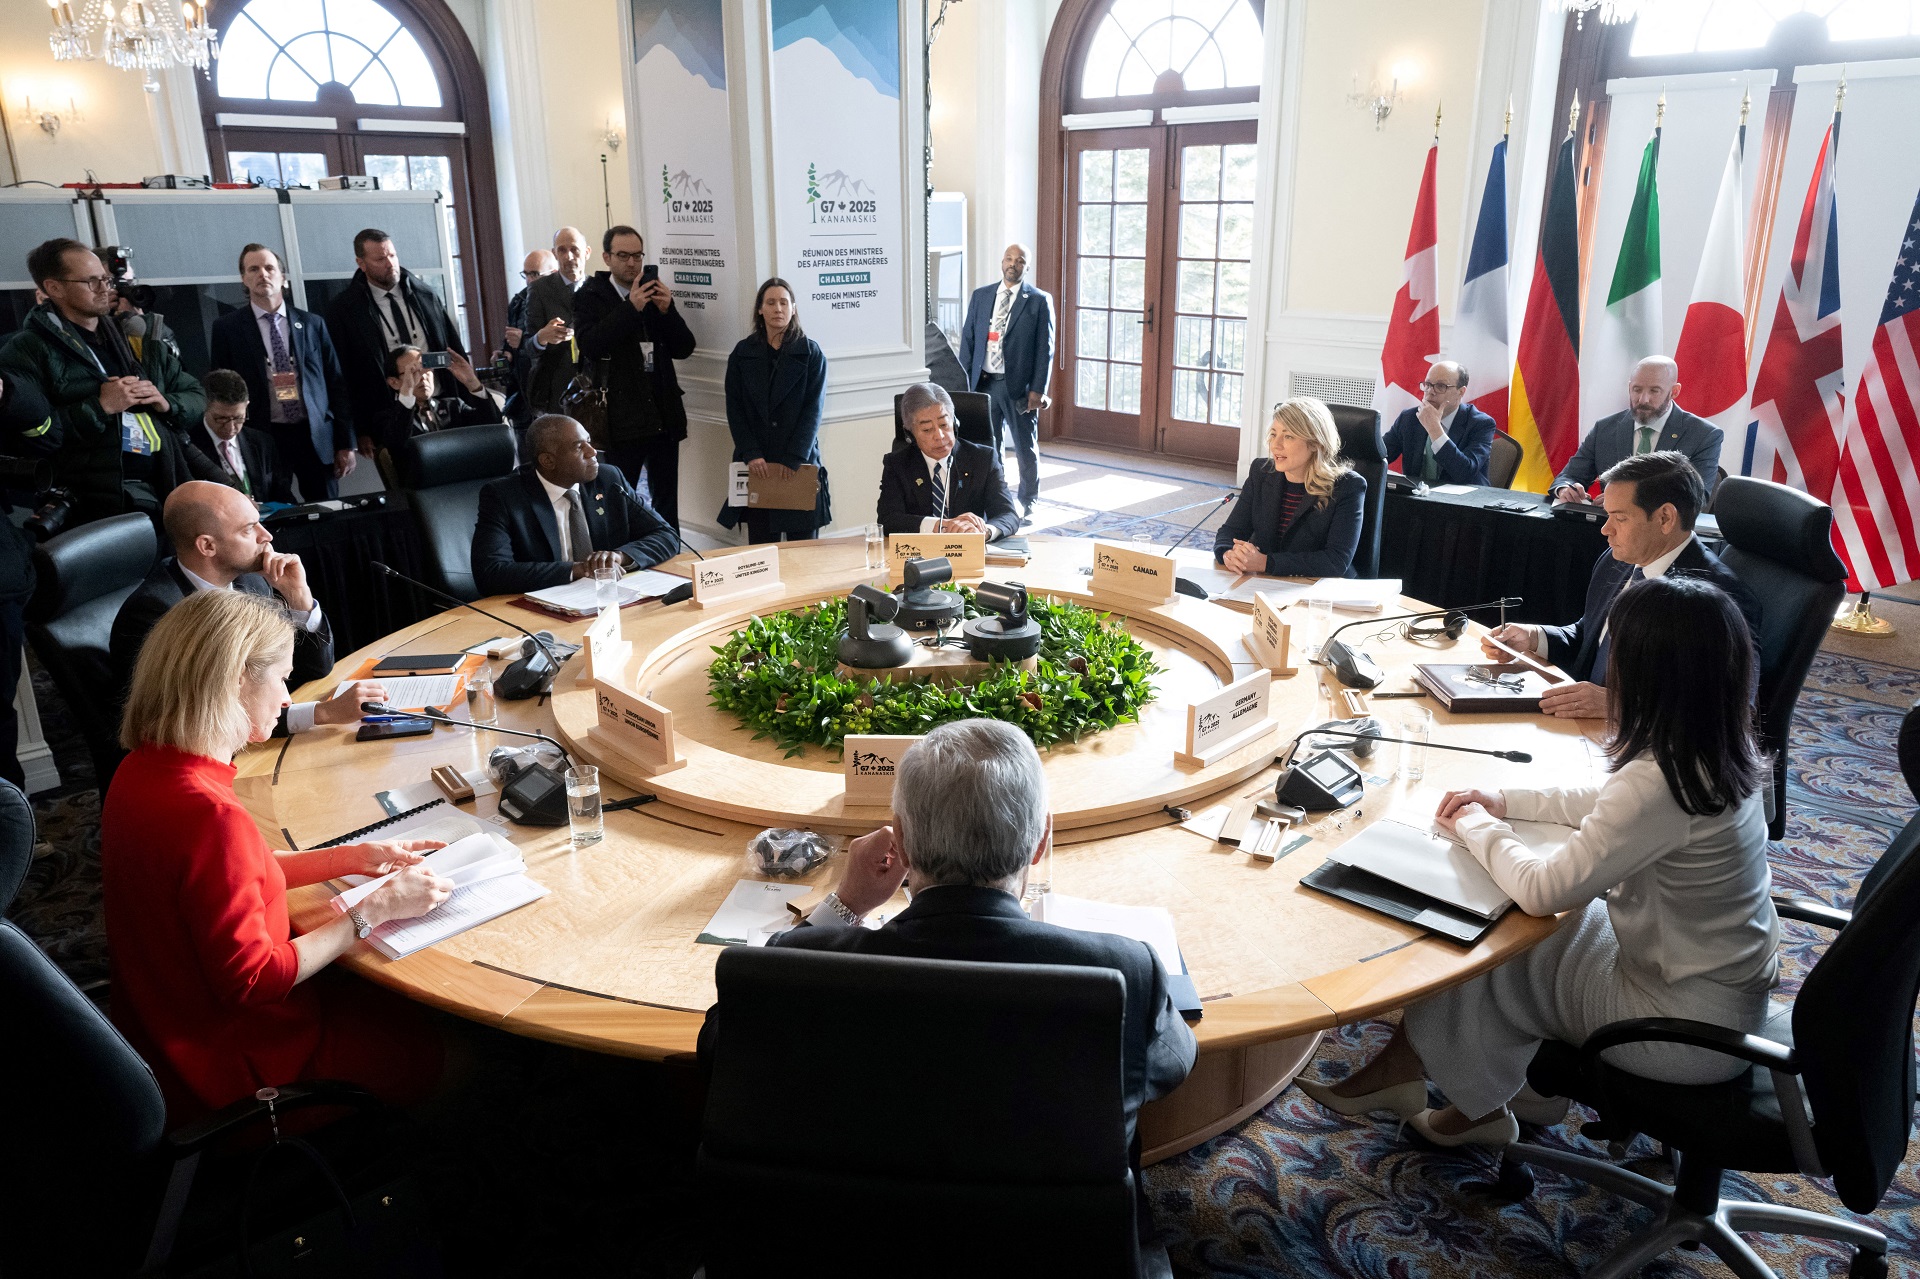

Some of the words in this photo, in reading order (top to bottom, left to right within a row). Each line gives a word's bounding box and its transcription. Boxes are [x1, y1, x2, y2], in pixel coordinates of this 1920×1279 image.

[672, 201, 682, 212] G7
[692, 201, 713, 212] 2025
[821, 201, 835, 212] G7
[849, 201, 876, 212] 2025
[673, 215, 714, 223] KANANASKIS
[821, 215, 876, 223] KANANASKIS
[662, 247, 683, 255] RÉUNION
[694, 249, 720, 257] MINISTRES
[803, 248, 833, 257] RÉUNION
[692, 258, 725, 267] ÉTRANGÈRES
[812, 259, 844, 267] AFFAIRES
[846, 257, 888, 266] ÉTRANGÈRES
[675, 274, 710, 283] CHARLEVOIX
[820, 274, 868, 283] CHARLEVOIX
[670, 290, 690, 298] FOREIGN
[812, 292, 841, 301] FOREIGN
[684, 301, 705, 309] MEETING
[832, 301, 860, 310] MEETING
[1133, 565, 1158, 576] CANADA
[1235, 692, 1256, 707] GERMANY
[1232, 702, 1258, 720] ALLEMAGNE
